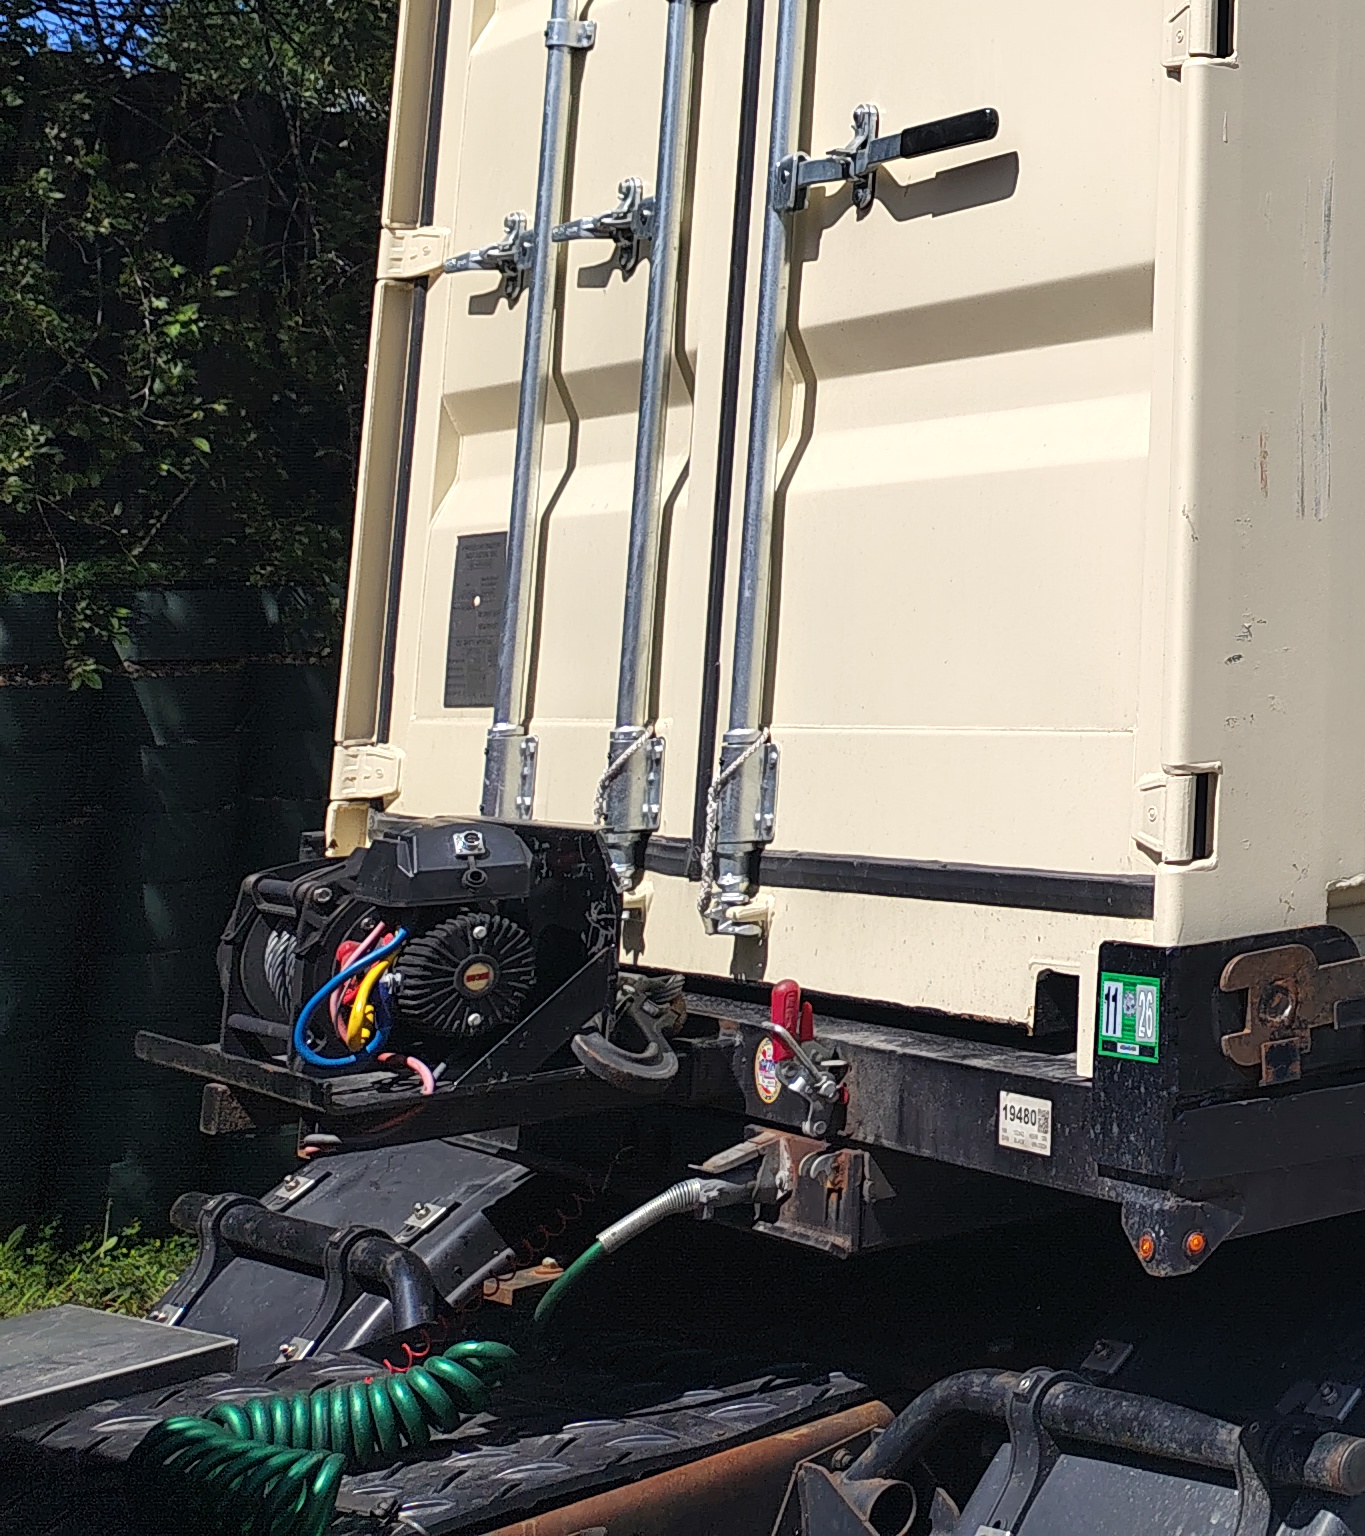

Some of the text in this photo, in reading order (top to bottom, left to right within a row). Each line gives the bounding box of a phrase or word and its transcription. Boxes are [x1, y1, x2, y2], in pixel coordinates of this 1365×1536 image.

[1105, 986, 1153, 1038] 11 26
[1003, 1104, 1037, 1126] 19480
